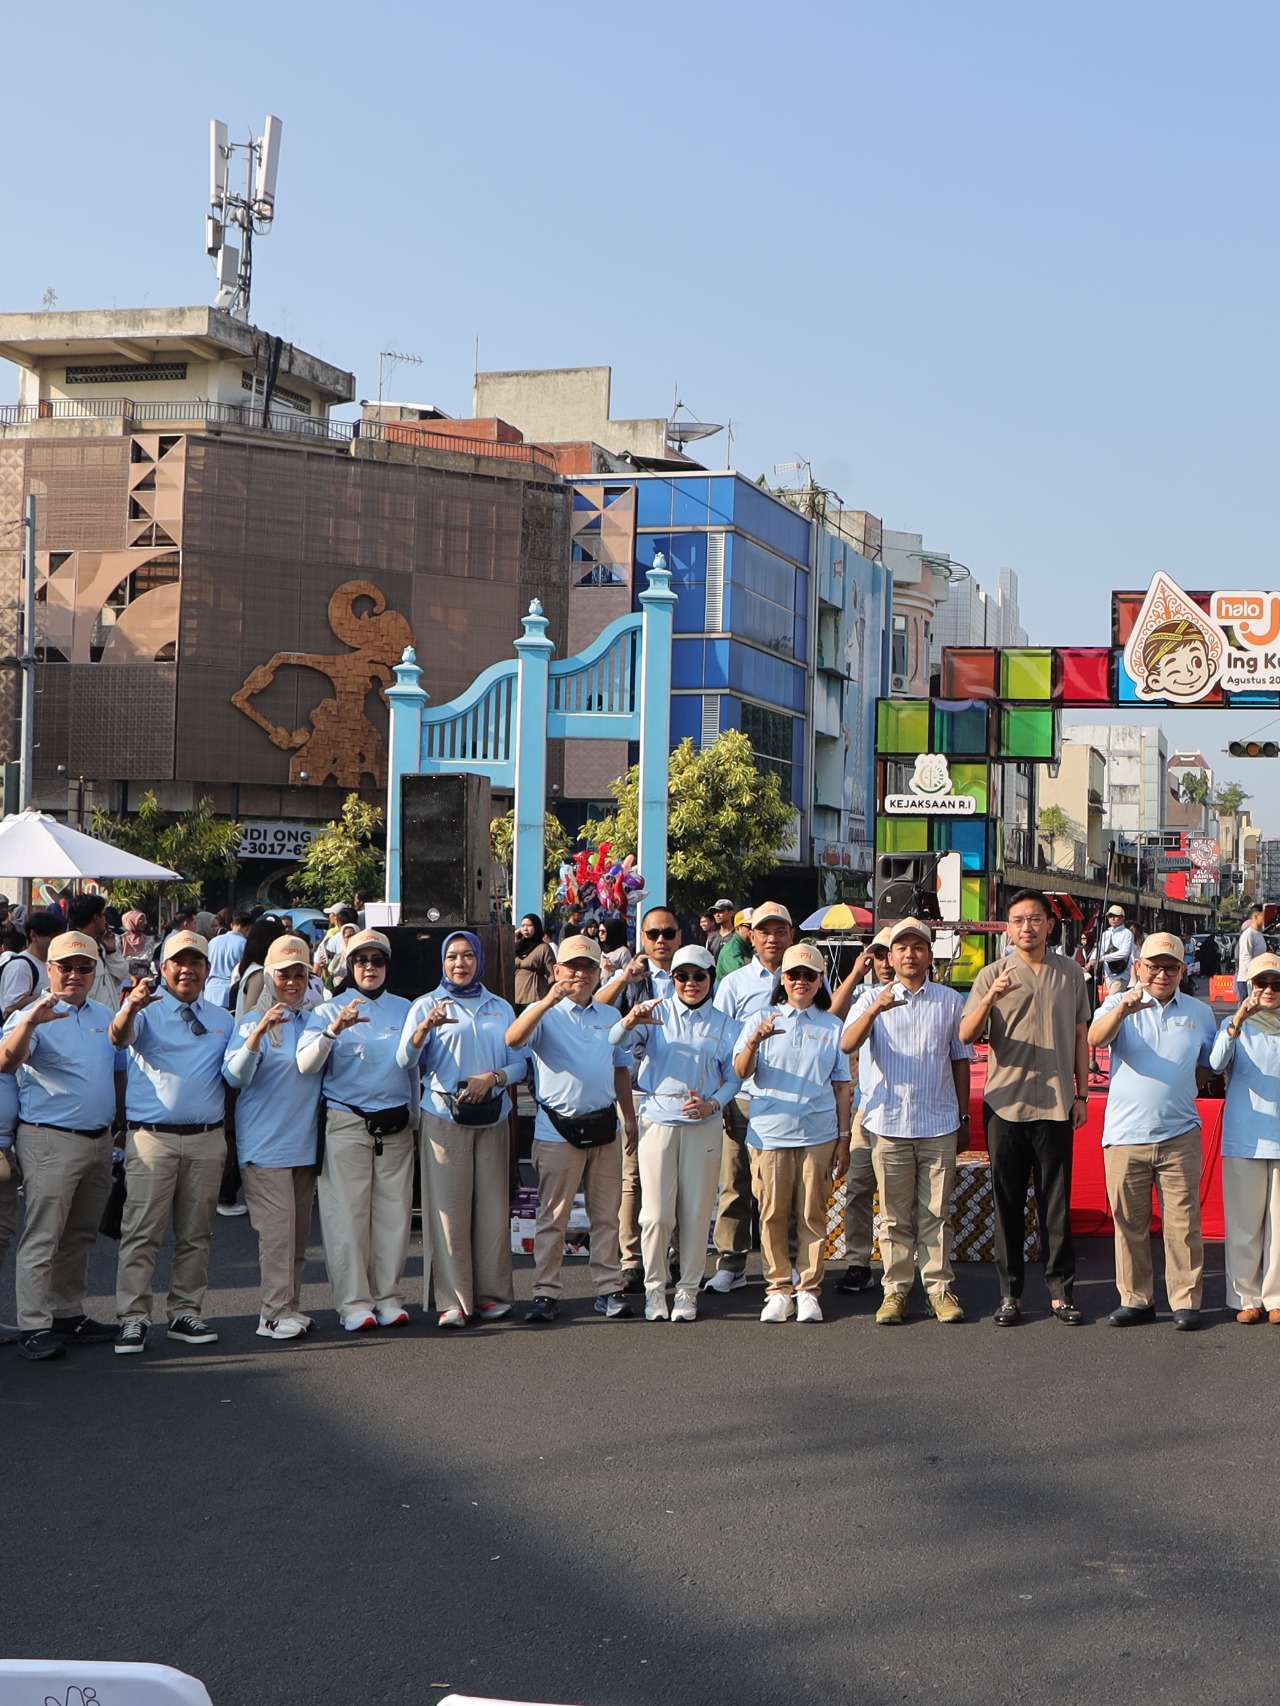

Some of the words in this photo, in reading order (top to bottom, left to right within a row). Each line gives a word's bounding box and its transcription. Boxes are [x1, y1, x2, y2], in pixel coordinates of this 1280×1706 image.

[1221, 599, 1260, 617] halo
[1226, 652, 1258, 674] Ing
[1226, 676, 1267, 686] Agustus
[889, 799, 956, 809] KEJAKSAAN
[958, 801, 971, 809] R.I
[273, 829, 312, 843] ONG
